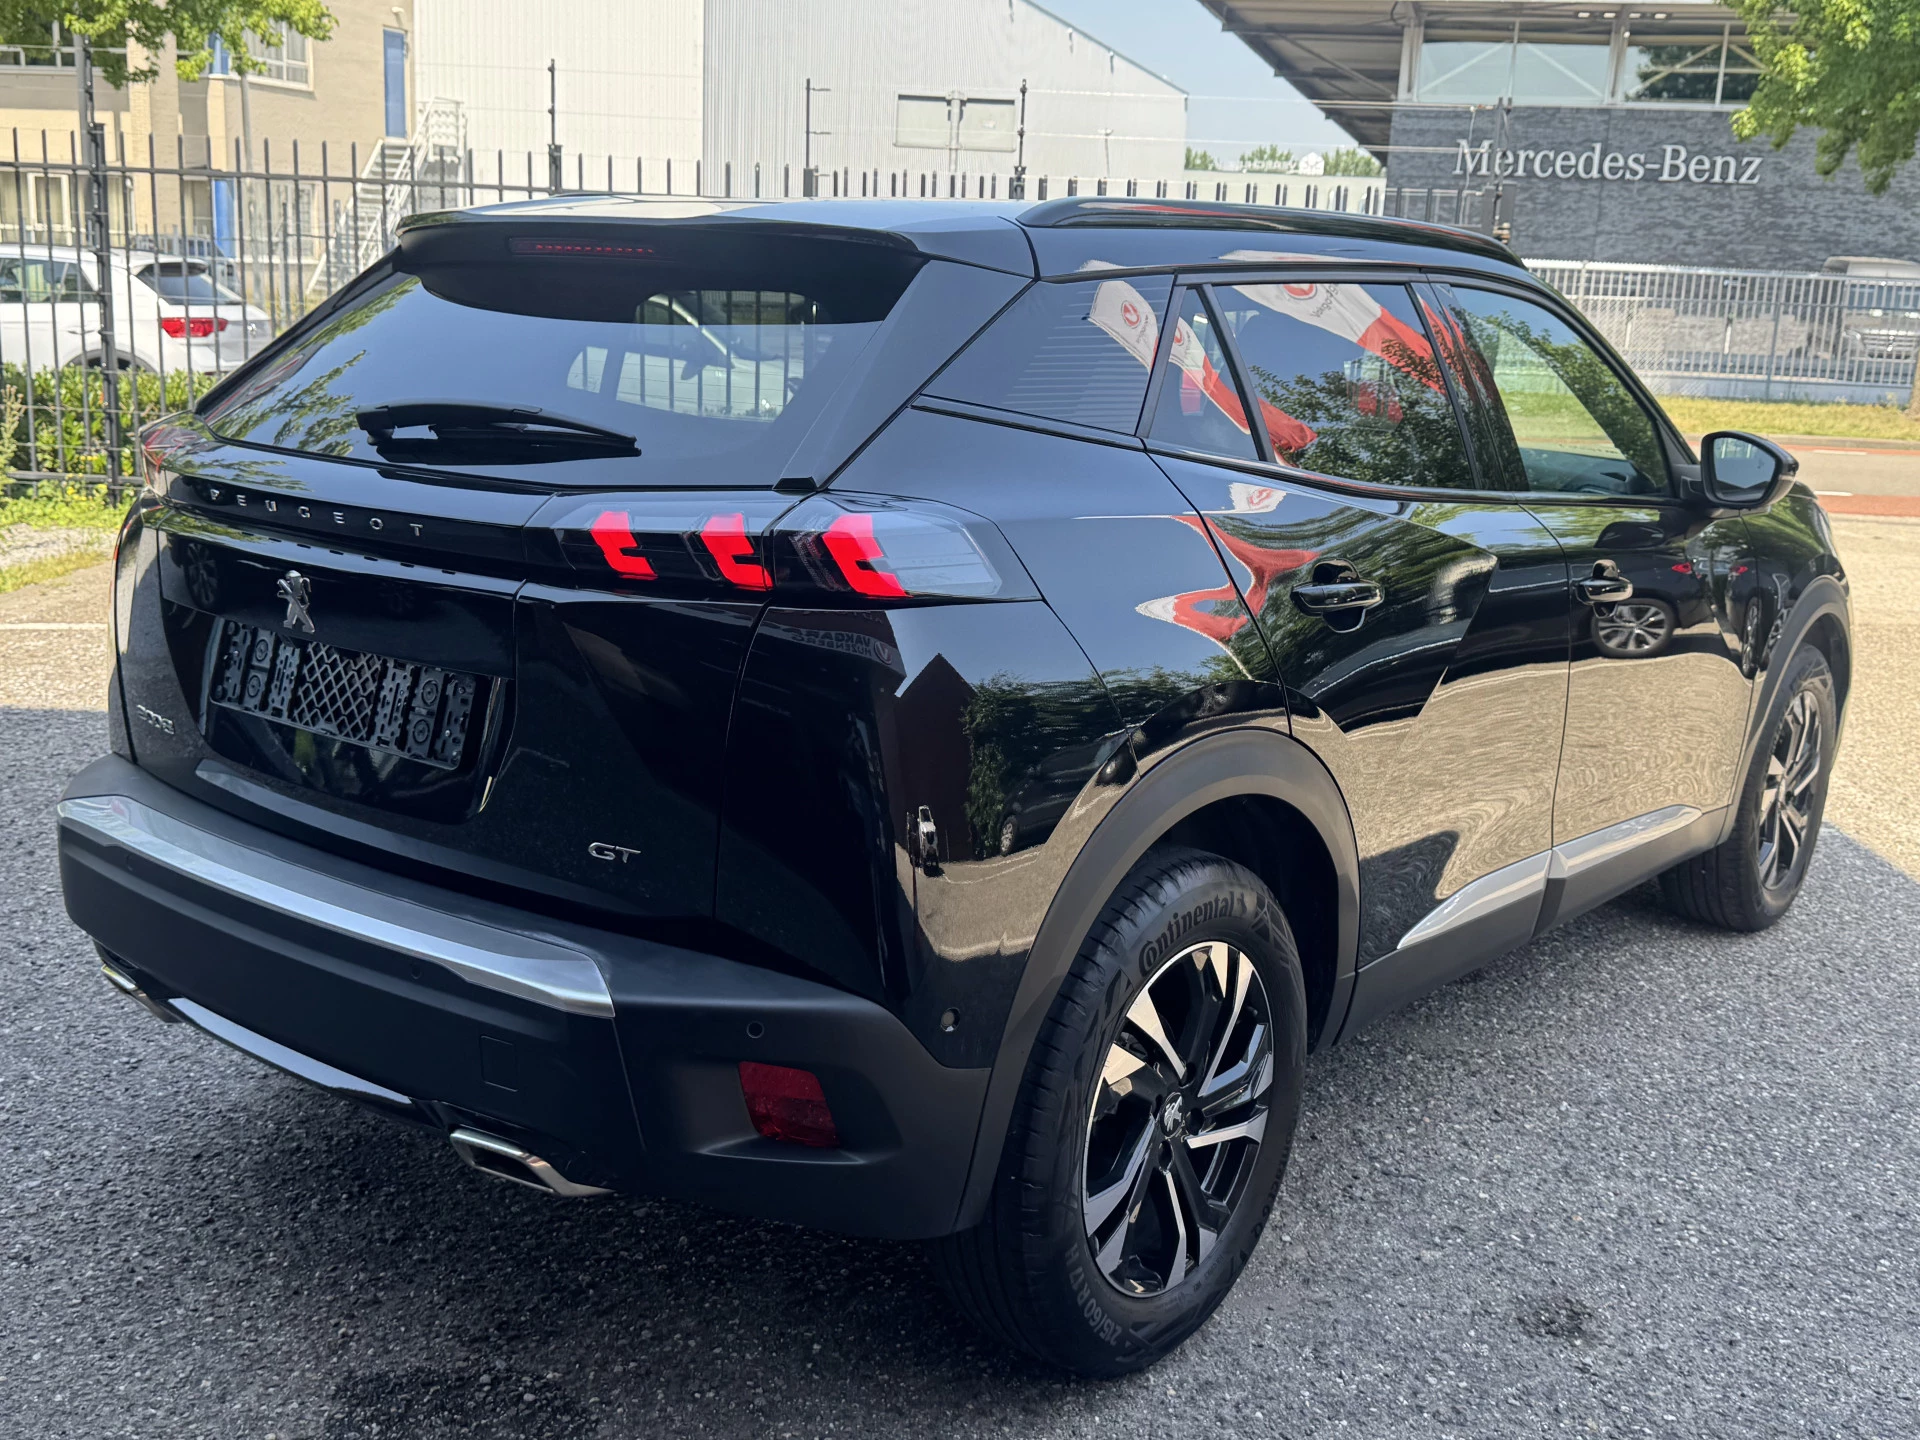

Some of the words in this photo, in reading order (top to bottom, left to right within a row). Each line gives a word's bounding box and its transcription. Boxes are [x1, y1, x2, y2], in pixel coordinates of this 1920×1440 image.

[1452, 139, 1763, 184] Mercedes-Benz
[209, 489, 423, 537] PEUGEOT
[588, 842, 641, 863] GT
[1139, 891, 1235, 976] Continental
